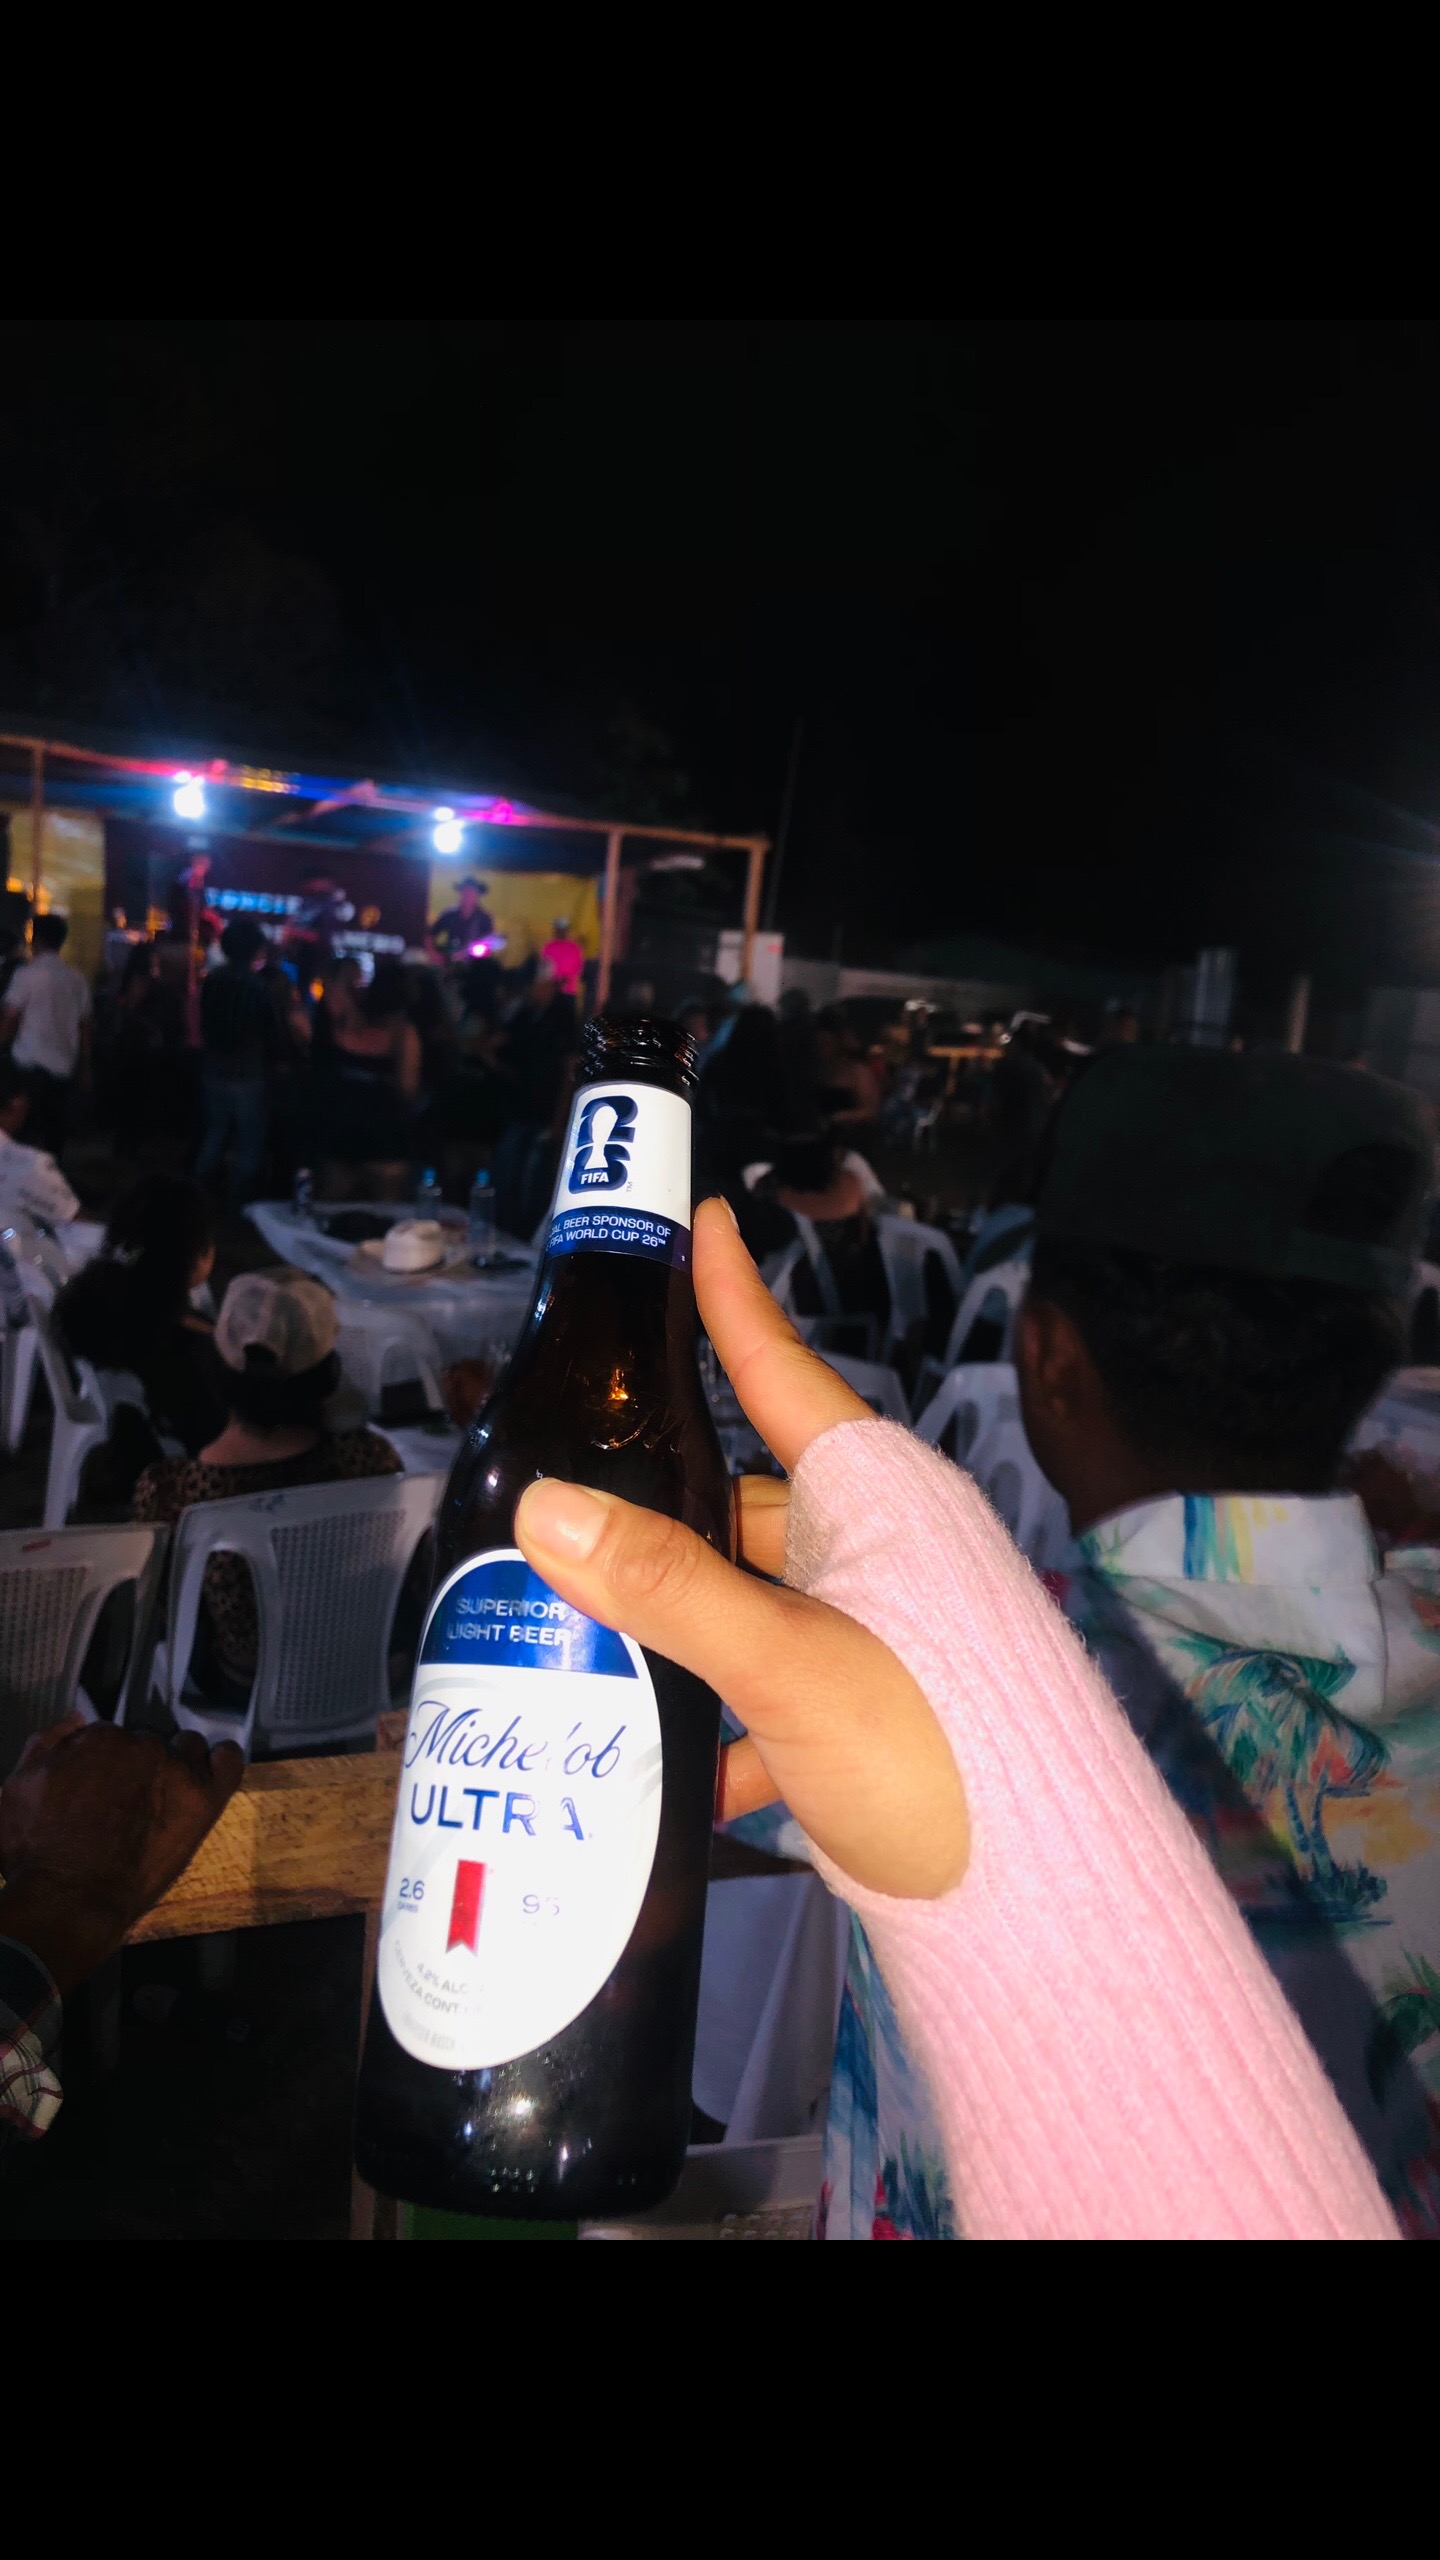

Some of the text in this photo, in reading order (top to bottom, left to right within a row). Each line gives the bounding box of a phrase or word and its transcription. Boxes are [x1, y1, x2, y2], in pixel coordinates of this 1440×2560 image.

[580, 1171, 610, 1185] FIFA
[563, 1216, 590, 1230] BEER
[592, 1215, 654, 1233] SPONSOR
[656, 1225, 672, 1237] OF
[566, 1228, 609, 1241] WORLD
[611, 1229, 640, 1242] CUP
[455, 1597, 566, 1622] SUPERIOR
[446, 1622, 572, 1649] LIGHT BEER
[410, 1782, 586, 1842] ULTRA
[399, 1877, 425, 1900] 2.6
